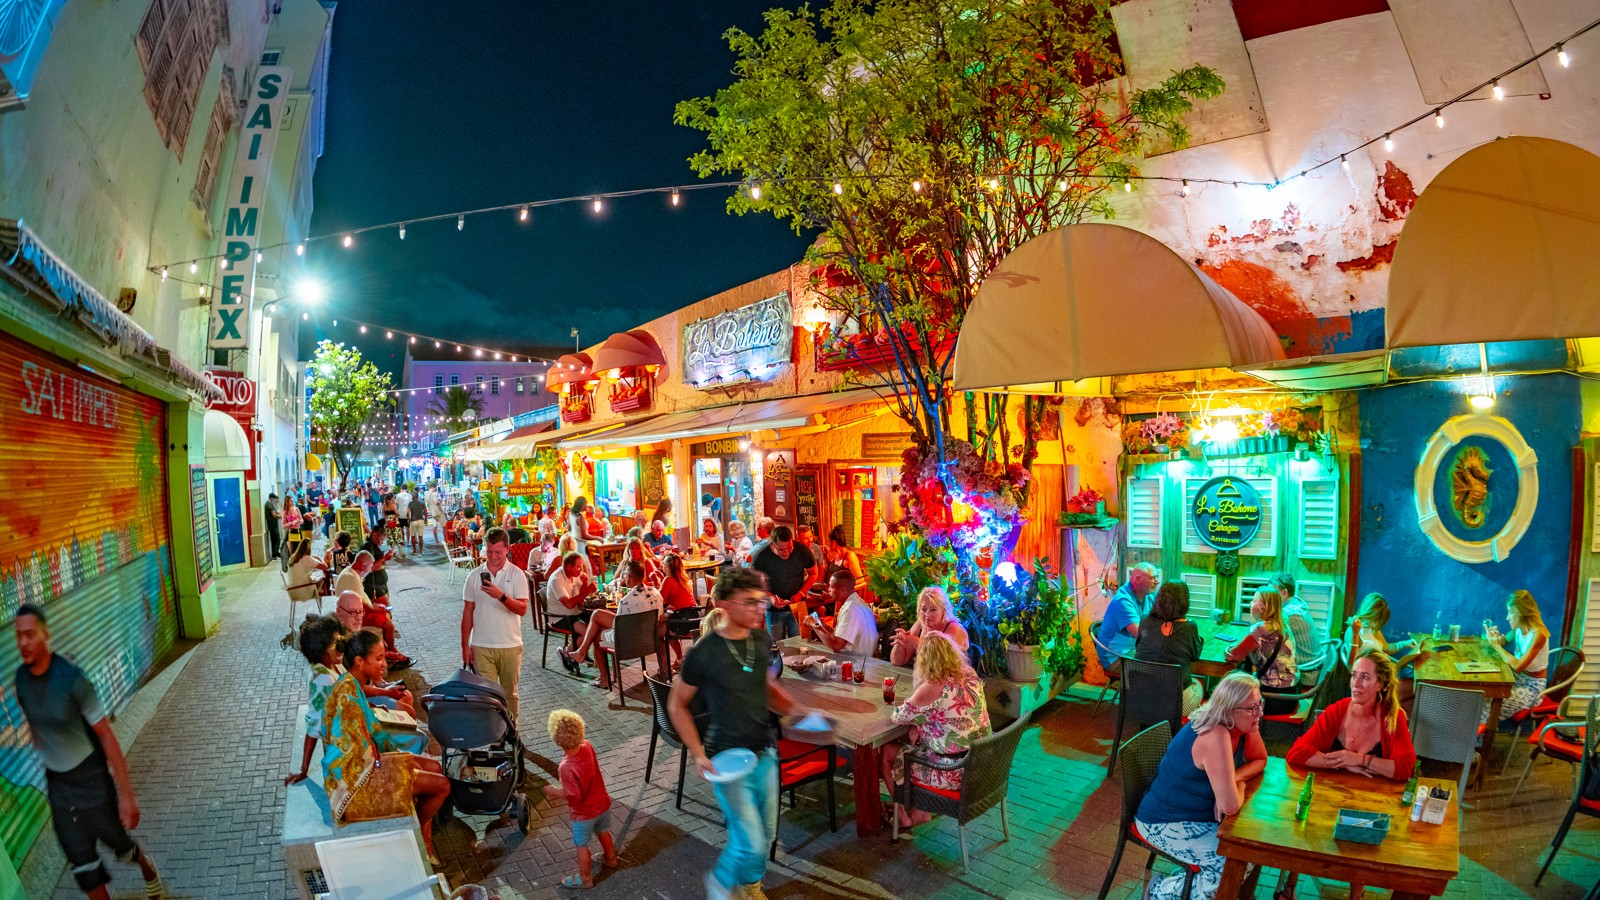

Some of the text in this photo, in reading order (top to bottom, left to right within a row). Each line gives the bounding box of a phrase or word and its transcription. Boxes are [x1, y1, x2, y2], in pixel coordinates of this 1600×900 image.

[215, 73, 282, 340] SAI IMPEX
[689, 323, 711, 362] La
[1196, 495, 1216, 514] La
[1211, 535, 1240, 544] Restaurant
